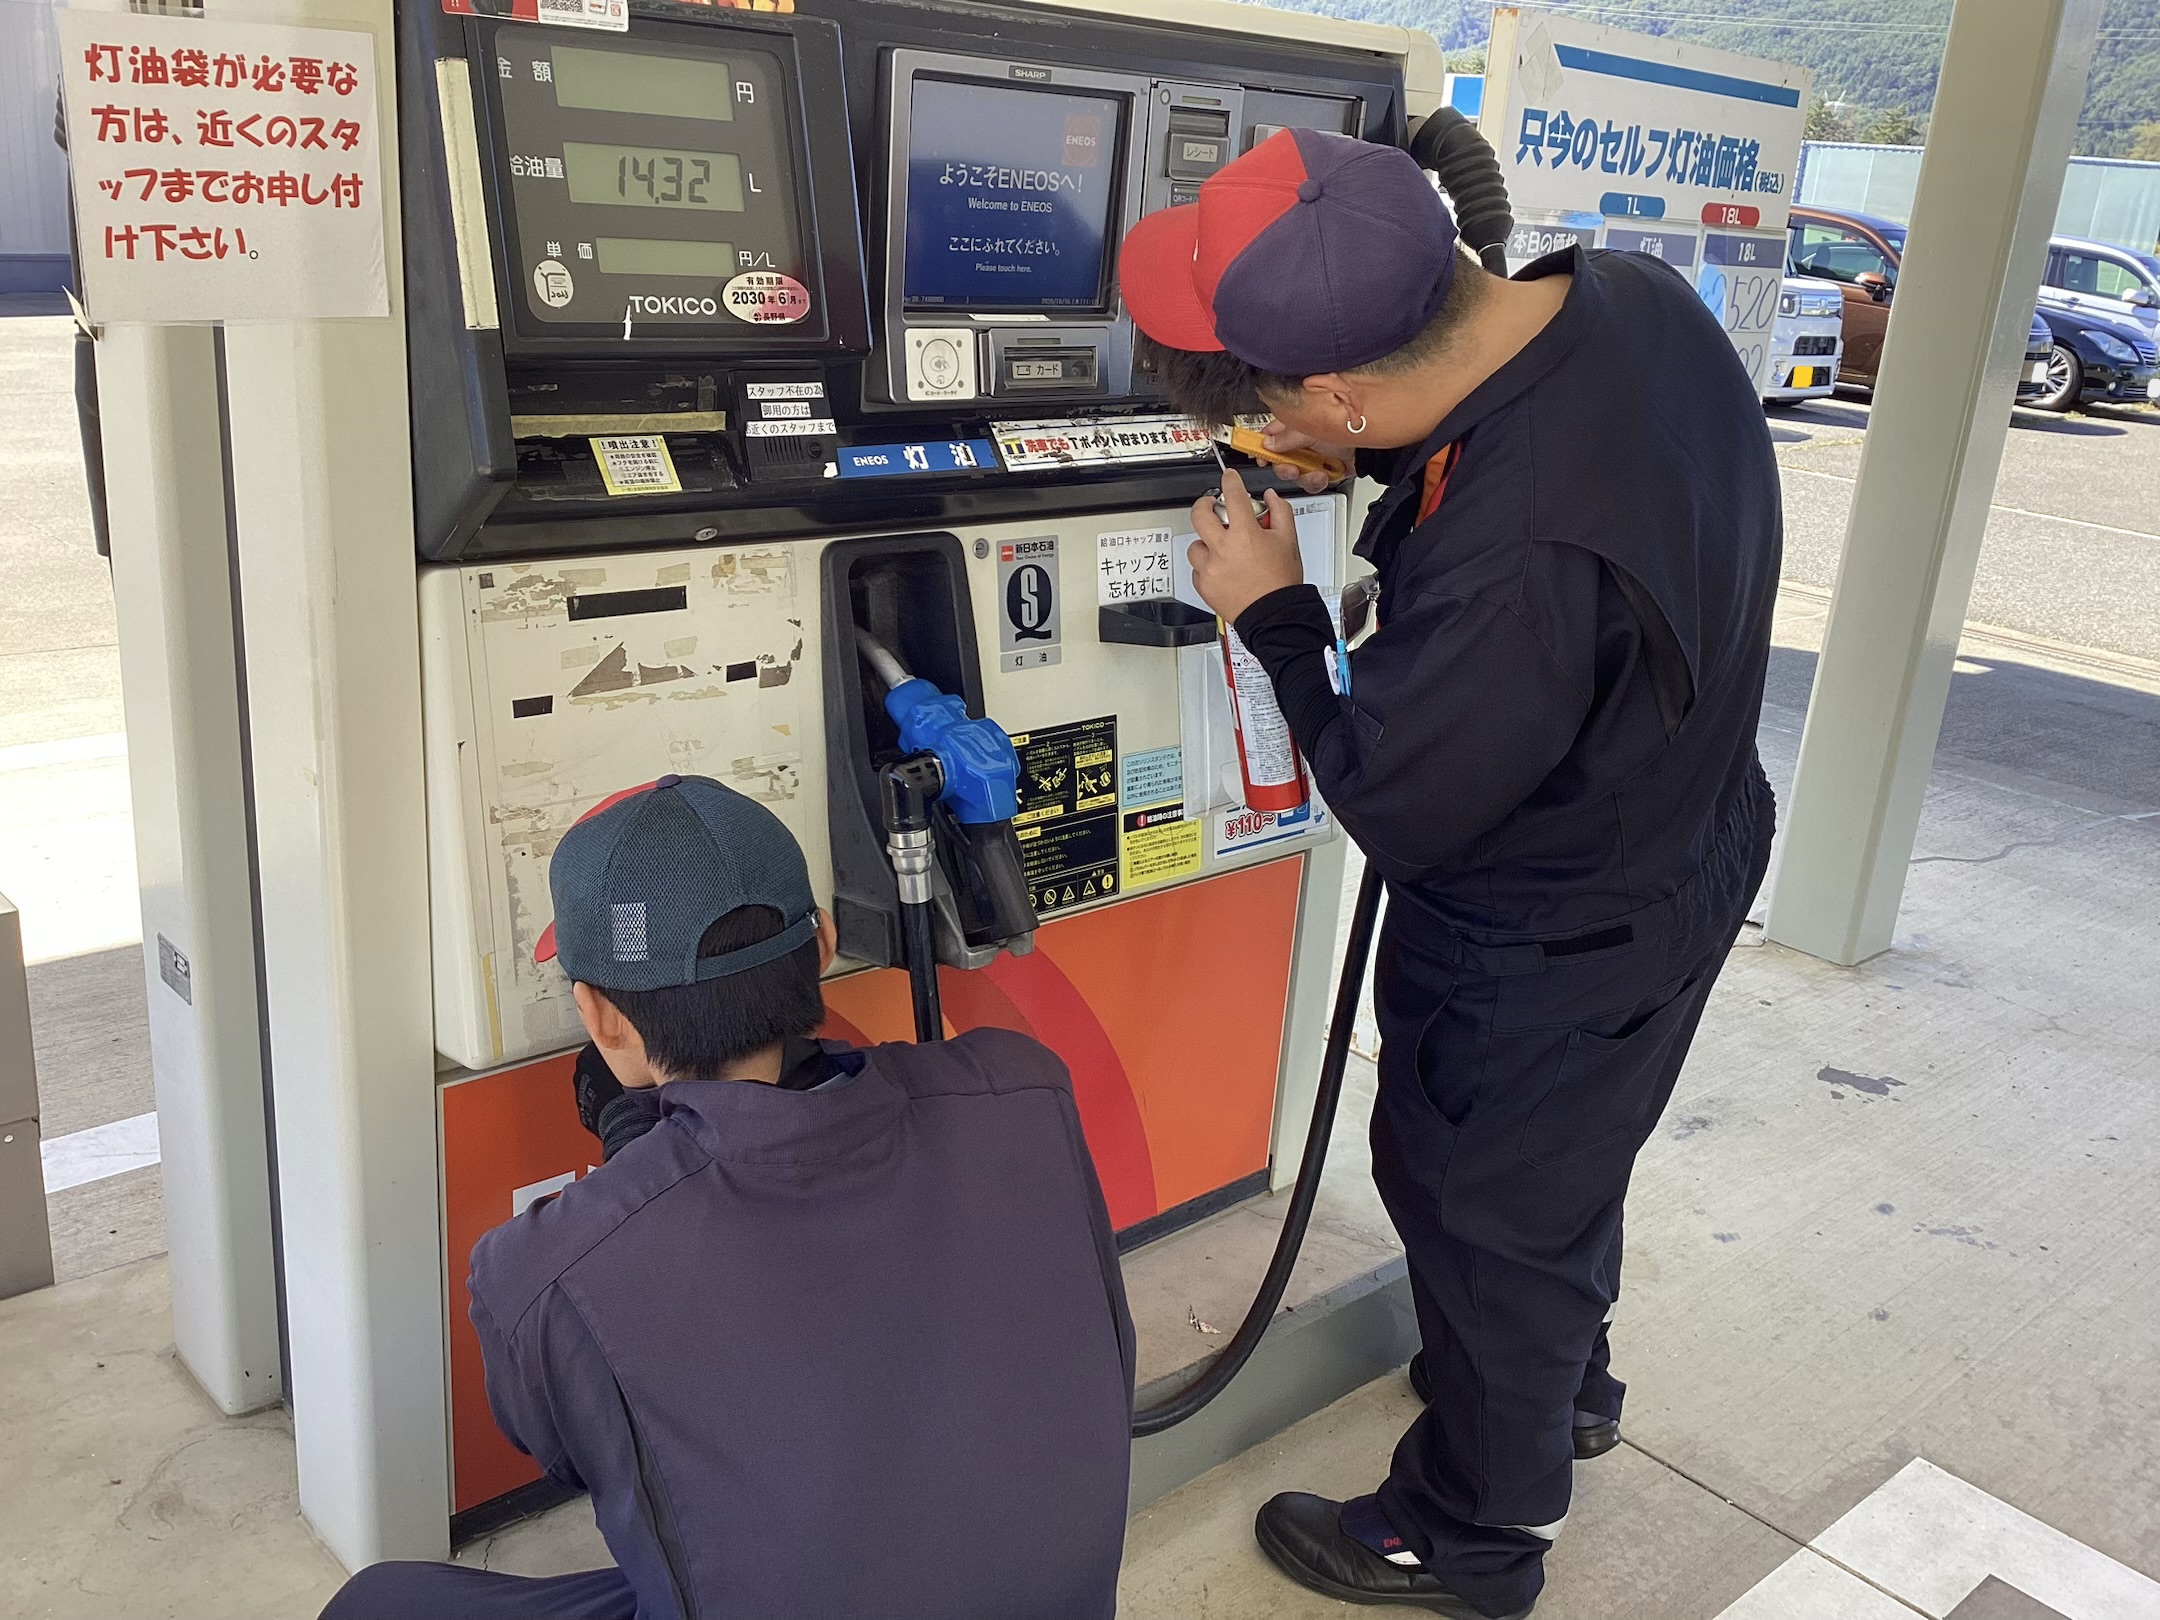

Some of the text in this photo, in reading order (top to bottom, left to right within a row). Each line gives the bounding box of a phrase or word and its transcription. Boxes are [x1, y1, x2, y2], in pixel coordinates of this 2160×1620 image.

[84, 43, 358, 96] 灯油袋が必要な
[1014, 68, 1046, 79] SHARP
[735, 82, 755, 103] 円
[91, 104, 361, 151] 方は、近くのスタ
[1066, 134, 1096, 148] ENEOS
[1187, 145, 1215, 158] レシート
[99, 168, 363, 208] ッフまでお申し付
[618, 156, 711, 204] 14.32
[749, 173, 762, 193] L
[968, 197, 1053, 213] Welcome to ENEOS
[1626, 196, 1641, 216] 1L
[1721, 206, 1742, 226] 18L
[105, 224, 259, 261] け下さい。
[948, 236, 1061, 257] ここにふれてください。
[1640, 236, 1664, 257] 灯油
[1738, 242, 1756, 262] 18L
[975, 262, 996, 273] Please
[997, 264, 1015, 273] touch
[629, 295, 717, 316] TOKICO
[1036, 363, 1058, 376] カード
[748, 385, 823, 397] スタッフ不在の為
[762, 404, 810, 416] 御用の方は
[853, 455, 889, 467] ENEOS
[1016, 541, 1054, 554] 新日本石油
[1100, 533, 1169, 548] 給油口キャップ置き
[1100, 552, 1169, 576] キャップを
[1081, 722, 1104, 731] TOKICO
